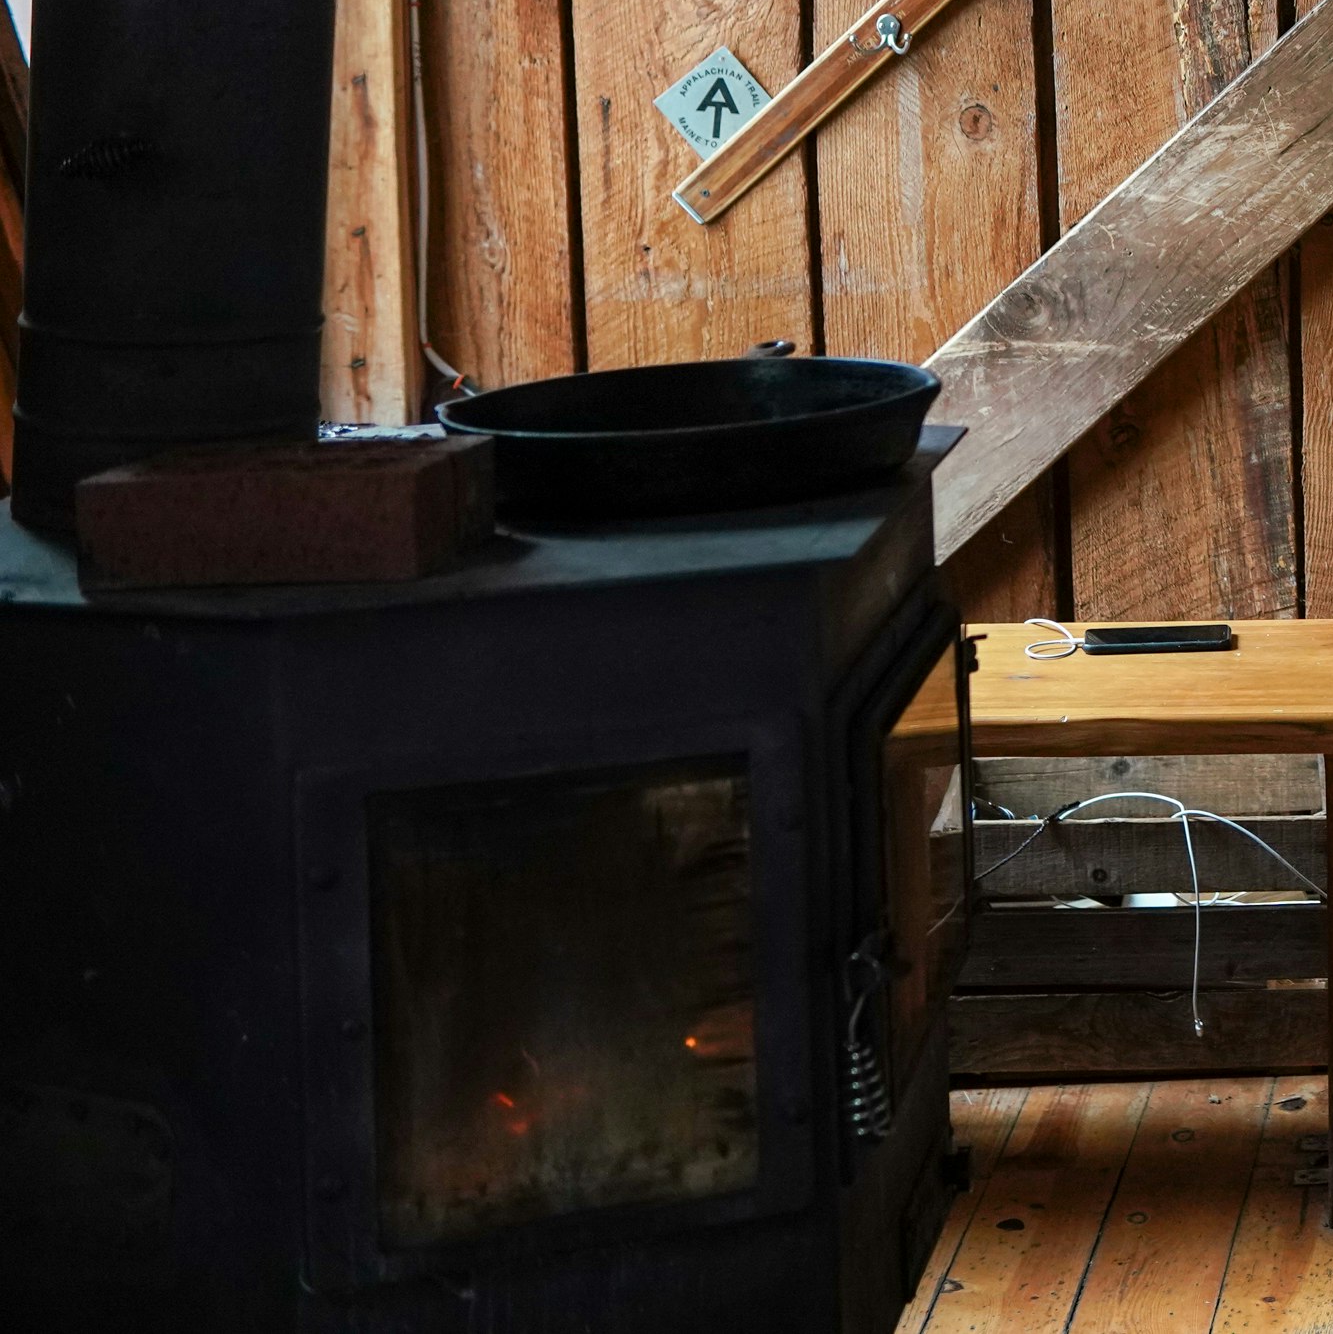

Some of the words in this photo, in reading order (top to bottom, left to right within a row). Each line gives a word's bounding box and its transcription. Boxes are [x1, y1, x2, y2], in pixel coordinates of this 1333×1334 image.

[679, 67, 743, 97] APPALACHIAN
[744, 80, 761, 108] TRAIL
[678, 116, 702, 143] MAINE
[704, 140, 718, 148] TO
